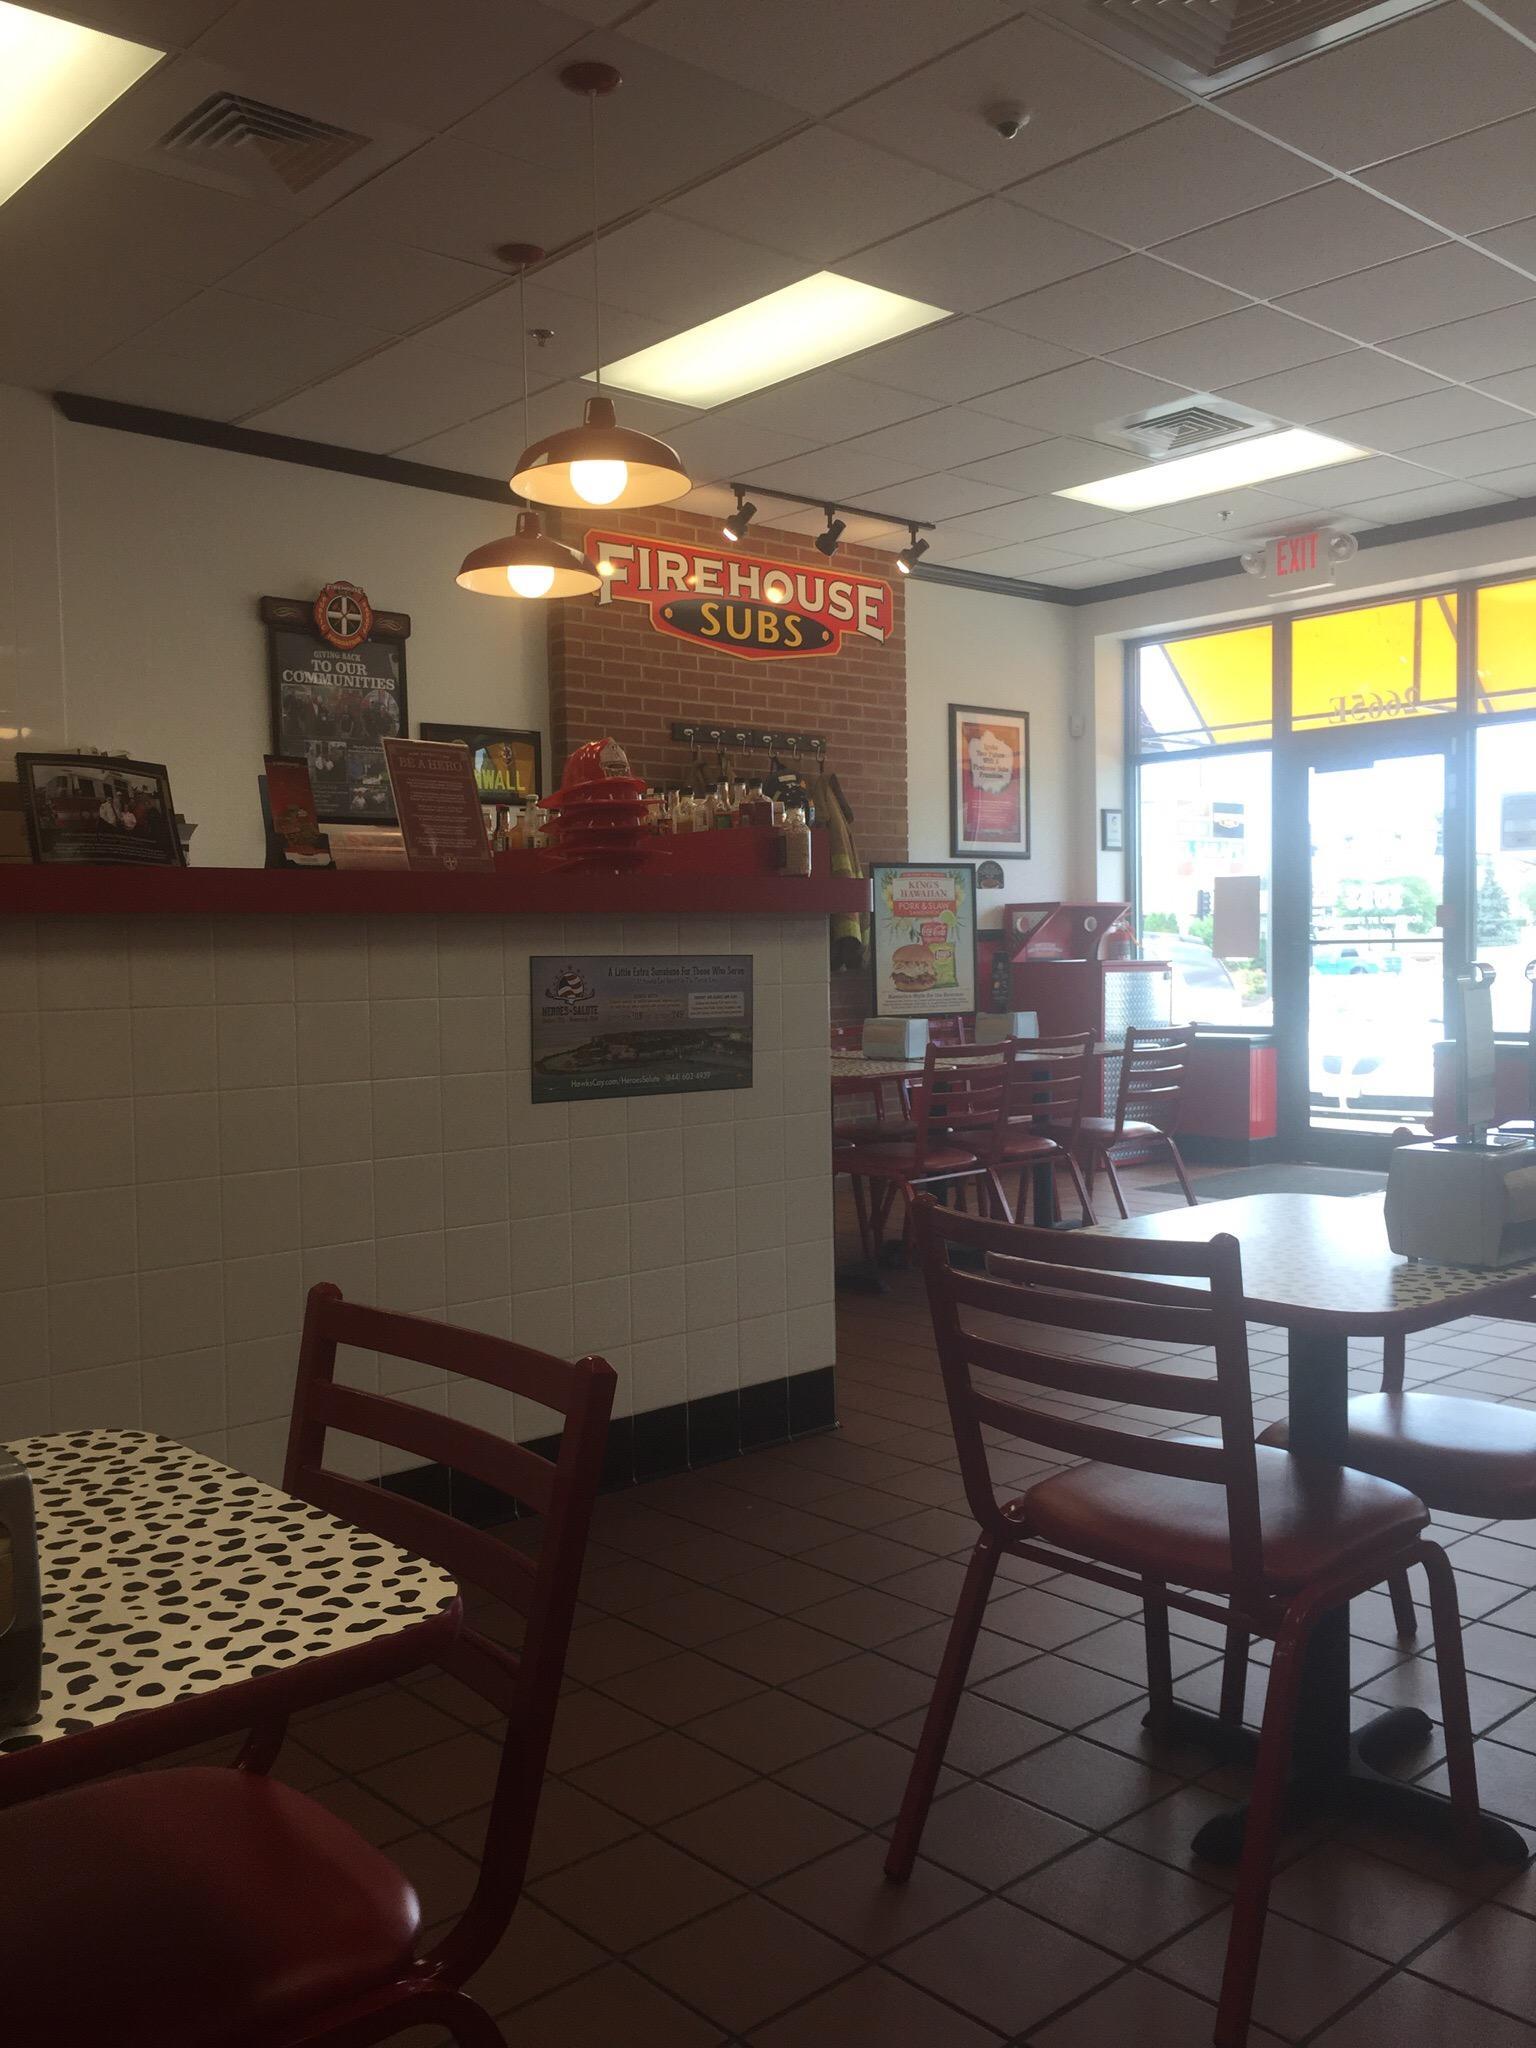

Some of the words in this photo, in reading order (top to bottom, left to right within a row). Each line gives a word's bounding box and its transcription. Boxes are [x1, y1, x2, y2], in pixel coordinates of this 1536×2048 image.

[1275, 532, 1319, 577] EXIT
[597, 541, 885, 643] FIREHOUSE
[699, 602, 803, 648] SUBS
[311, 659, 332, 672] TO
[335, 662, 368, 676] OUR
[282, 669, 395, 690] COMMUNITIES
[418, 759, 426, 769] A
[908, 880, 939, 889] KING'S
